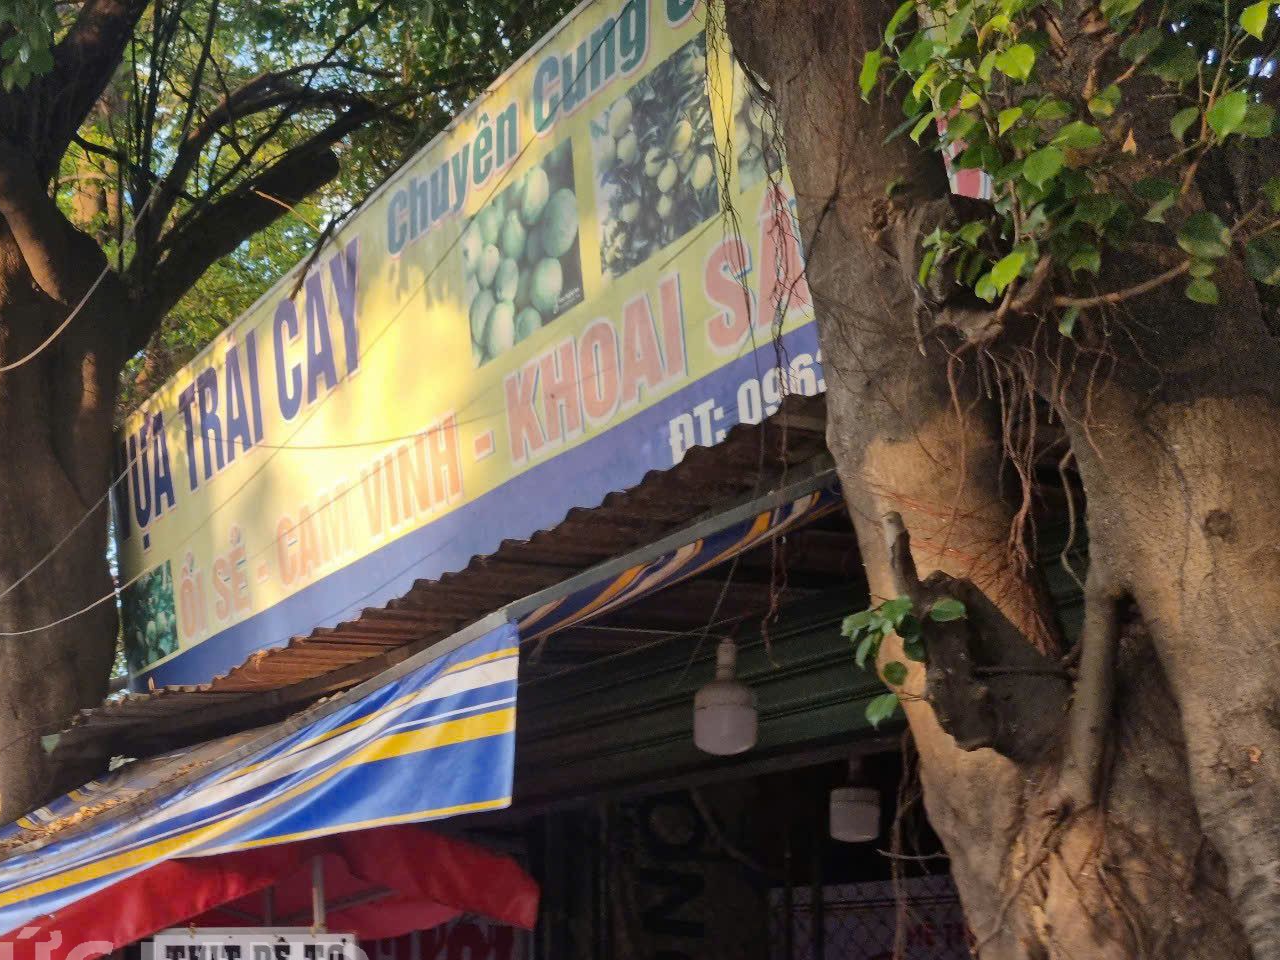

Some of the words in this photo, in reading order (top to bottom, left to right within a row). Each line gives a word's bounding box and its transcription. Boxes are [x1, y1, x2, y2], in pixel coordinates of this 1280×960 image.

[386, 102, 518, 255] Chuyên
[532, 0, 649, 133] Cung
[361, 415, 462, 538] VINH
[504, 274, 685, 463] KHOAI
